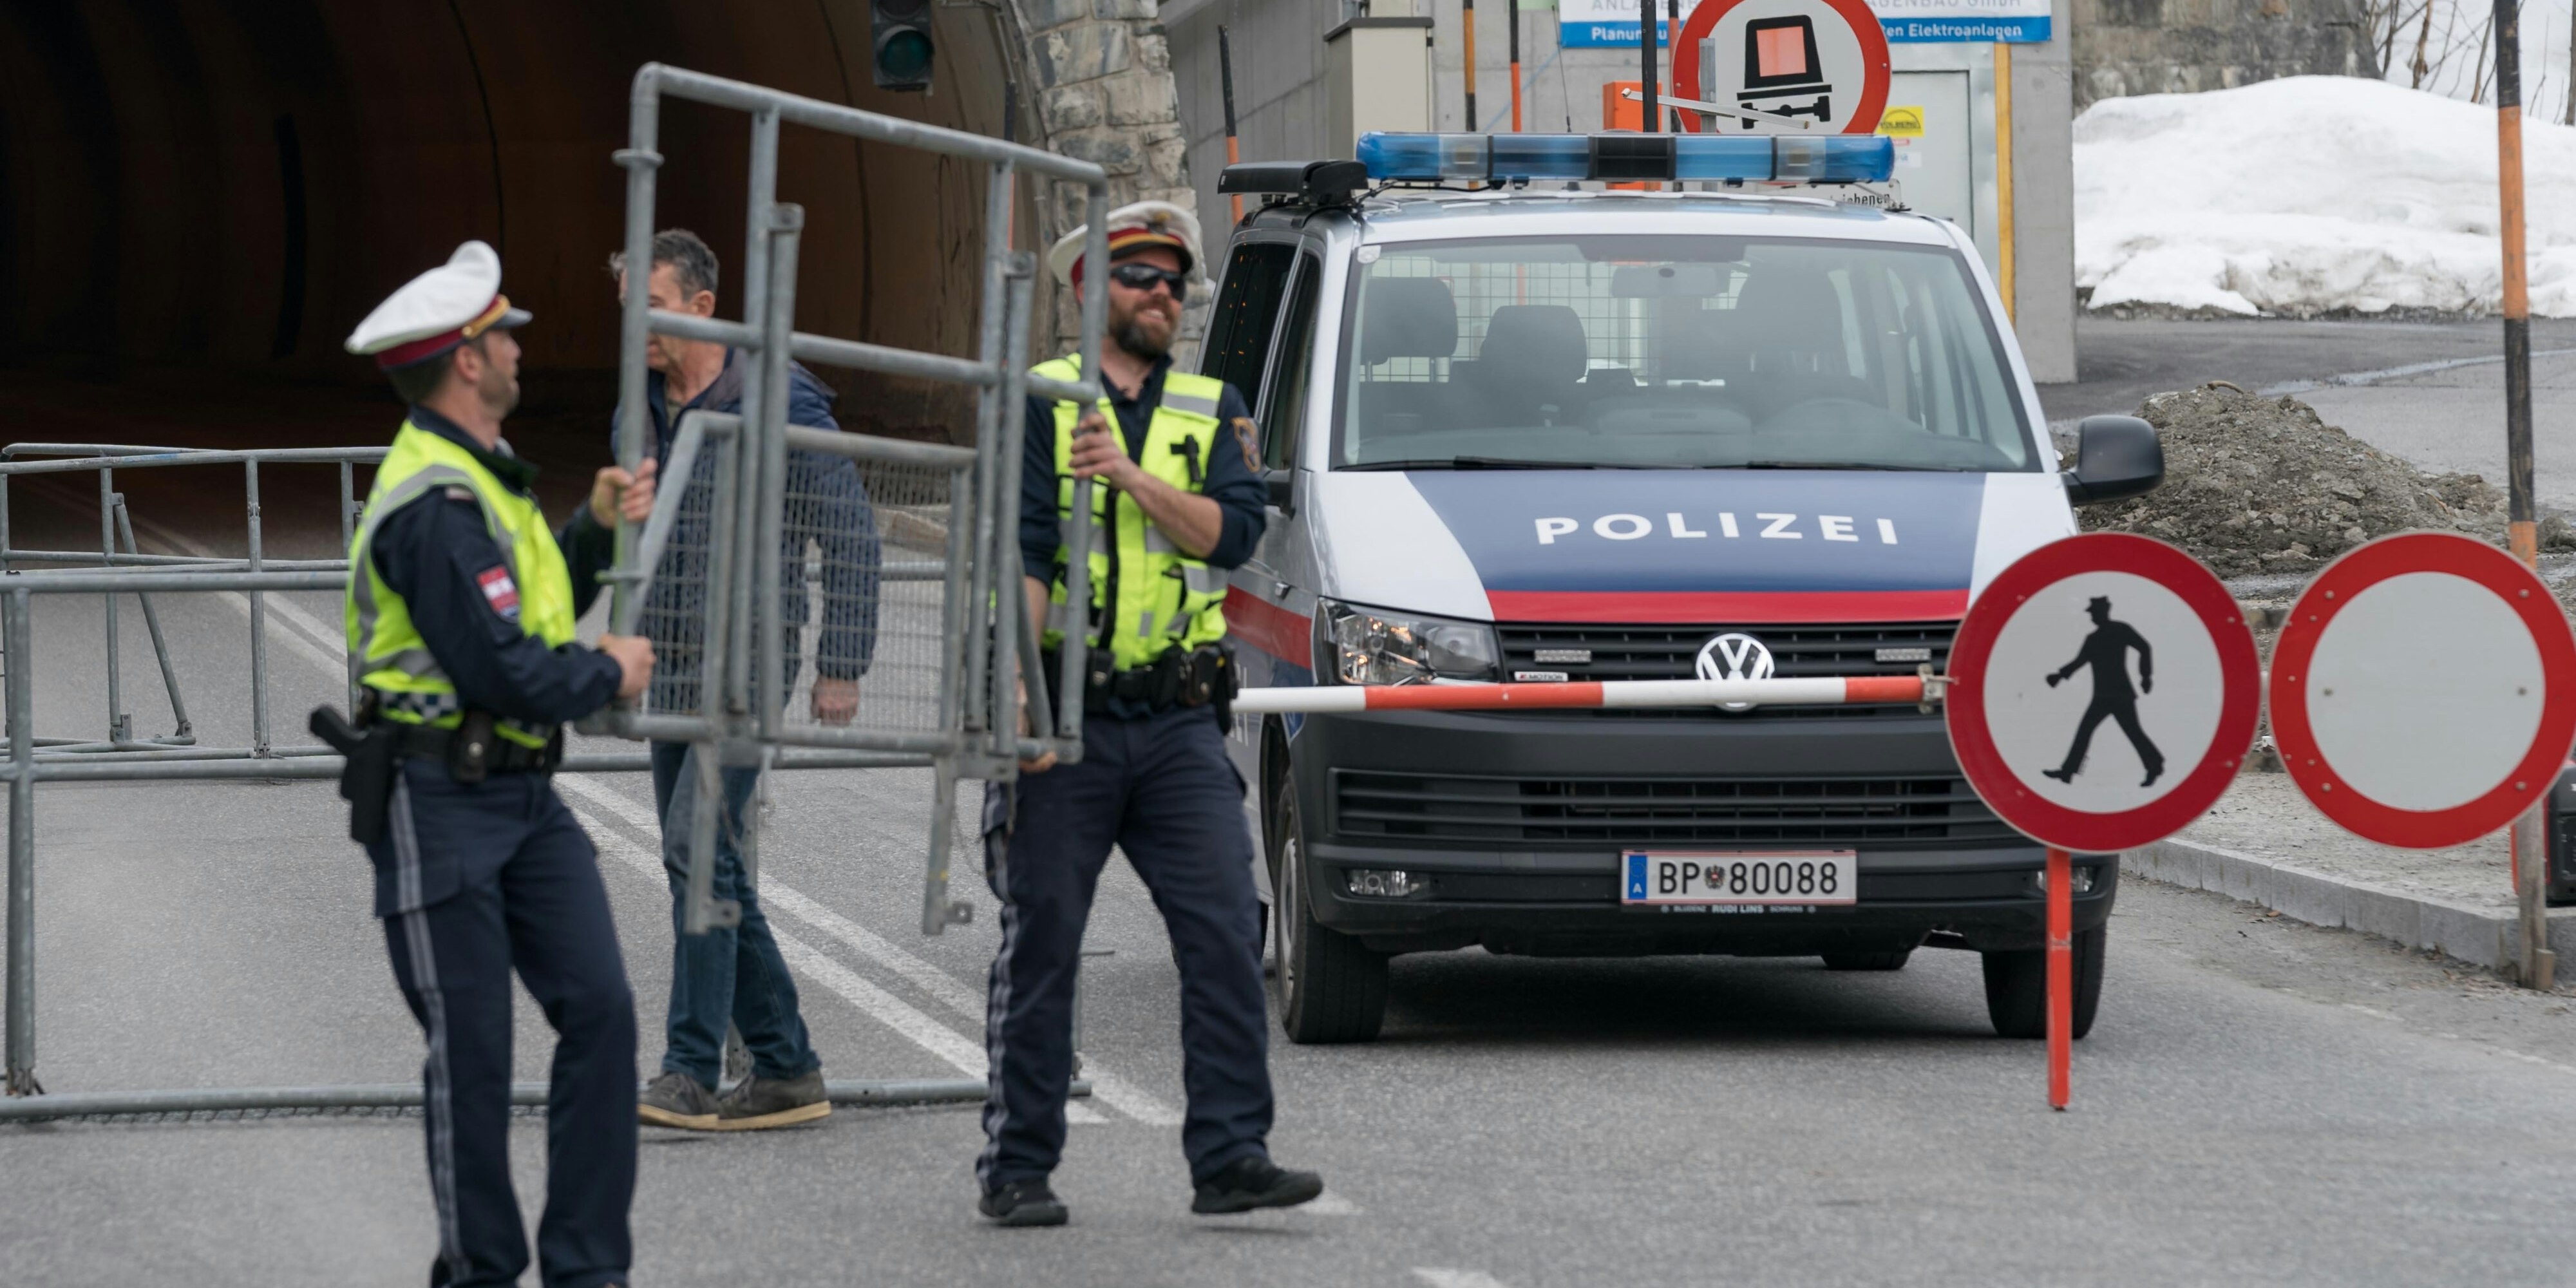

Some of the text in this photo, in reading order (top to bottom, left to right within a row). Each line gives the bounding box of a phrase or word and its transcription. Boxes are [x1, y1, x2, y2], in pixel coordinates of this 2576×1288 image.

[1592, 26, 1642, 41] Planun
[1909, 23, 2022, 41] Elektroanlagen
[1535, 513, 1898, 544] POLIZEI
[1633, 882, 1642, 894] A
[1660, 862, 1837, 895] BP 80088
